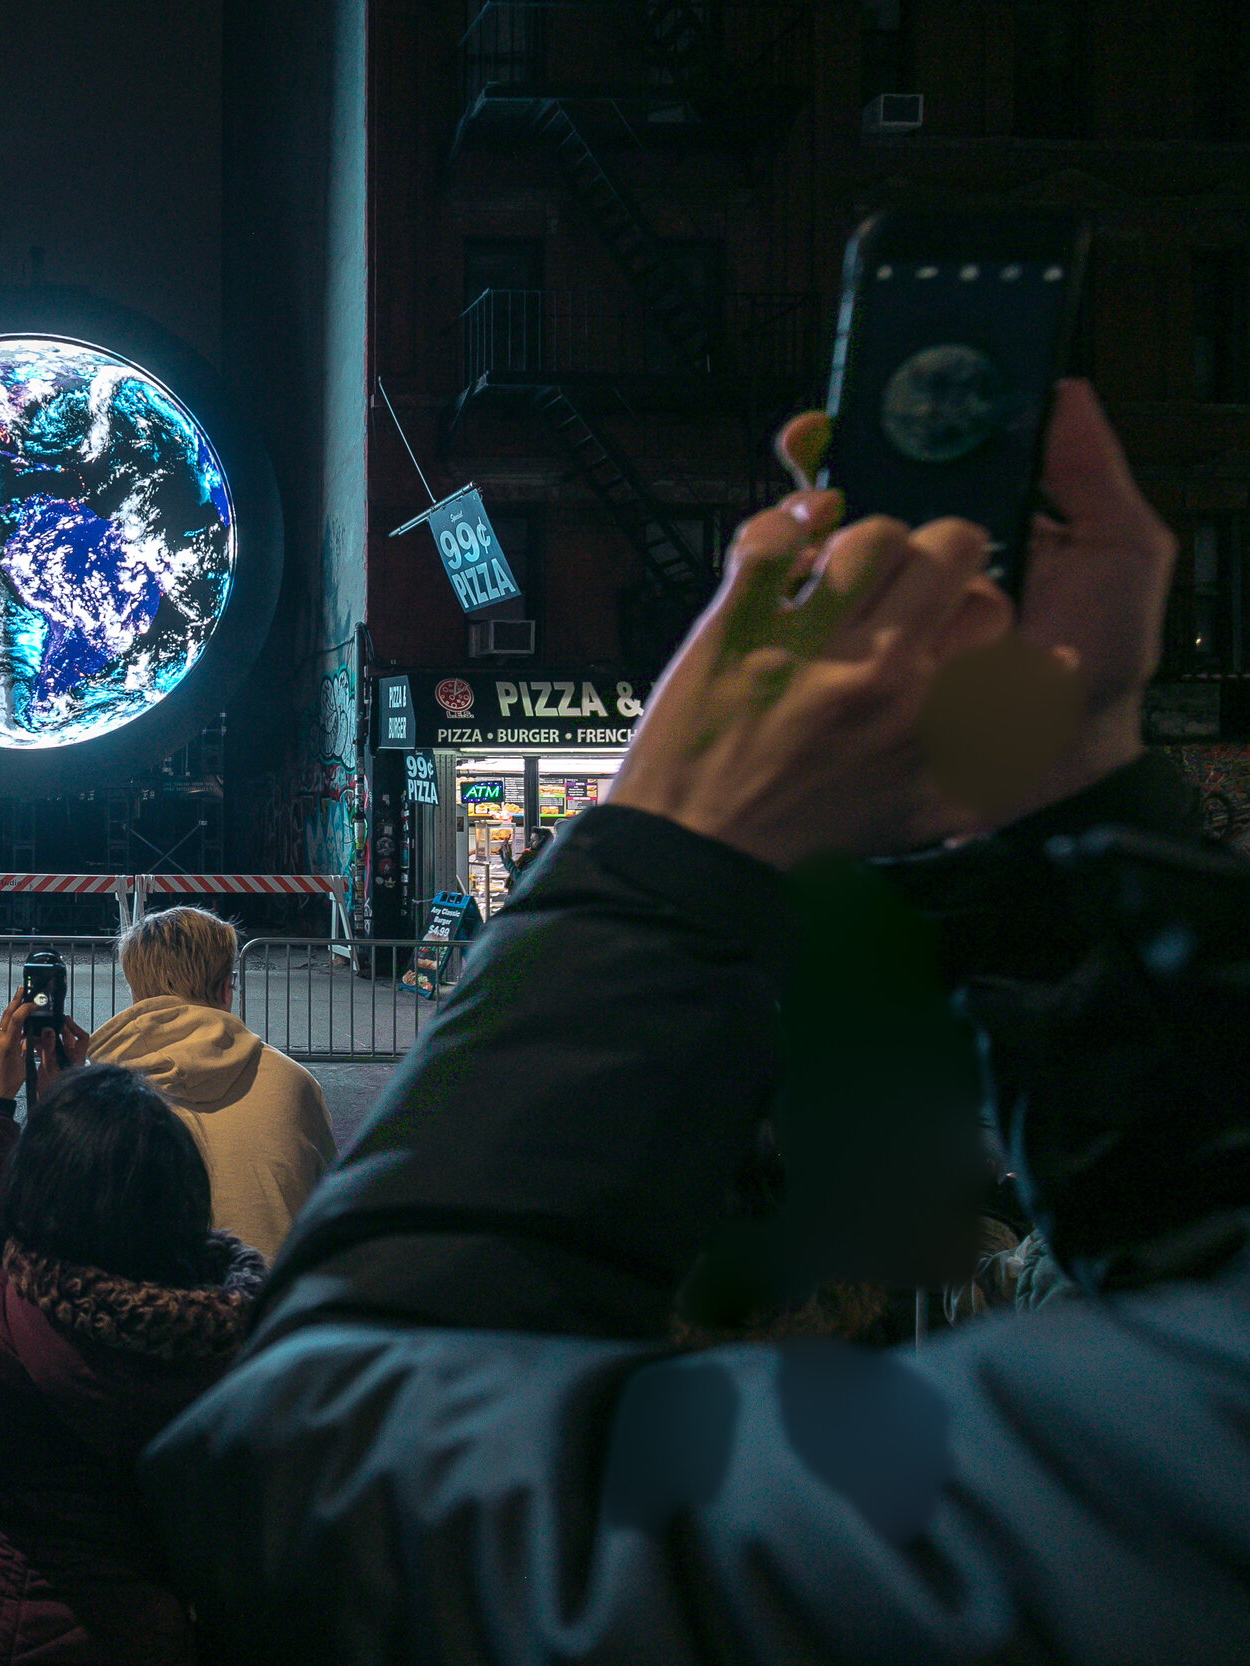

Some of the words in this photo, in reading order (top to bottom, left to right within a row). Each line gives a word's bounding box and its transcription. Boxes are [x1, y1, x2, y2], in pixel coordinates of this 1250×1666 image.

[439, 516, 491, 570] 99¢
[451, 558, 516, 608] PIZZA
[389, 685, 403, 708] PIZZA
[495, 681, 609, 717] PIZZA
[616, 681, 645, 718] &
[389, 717, 407, 738] BURGER
[437, 729, 483, 743] PIZZA
[497, 728, 560, 743] BURGER
[577, 728, 638, 743] FRENCH
[406, 755, 434, 779] 99¢
[407, 779, 439, 805] PIZZA
[466, 785, 500, 798] ATM
